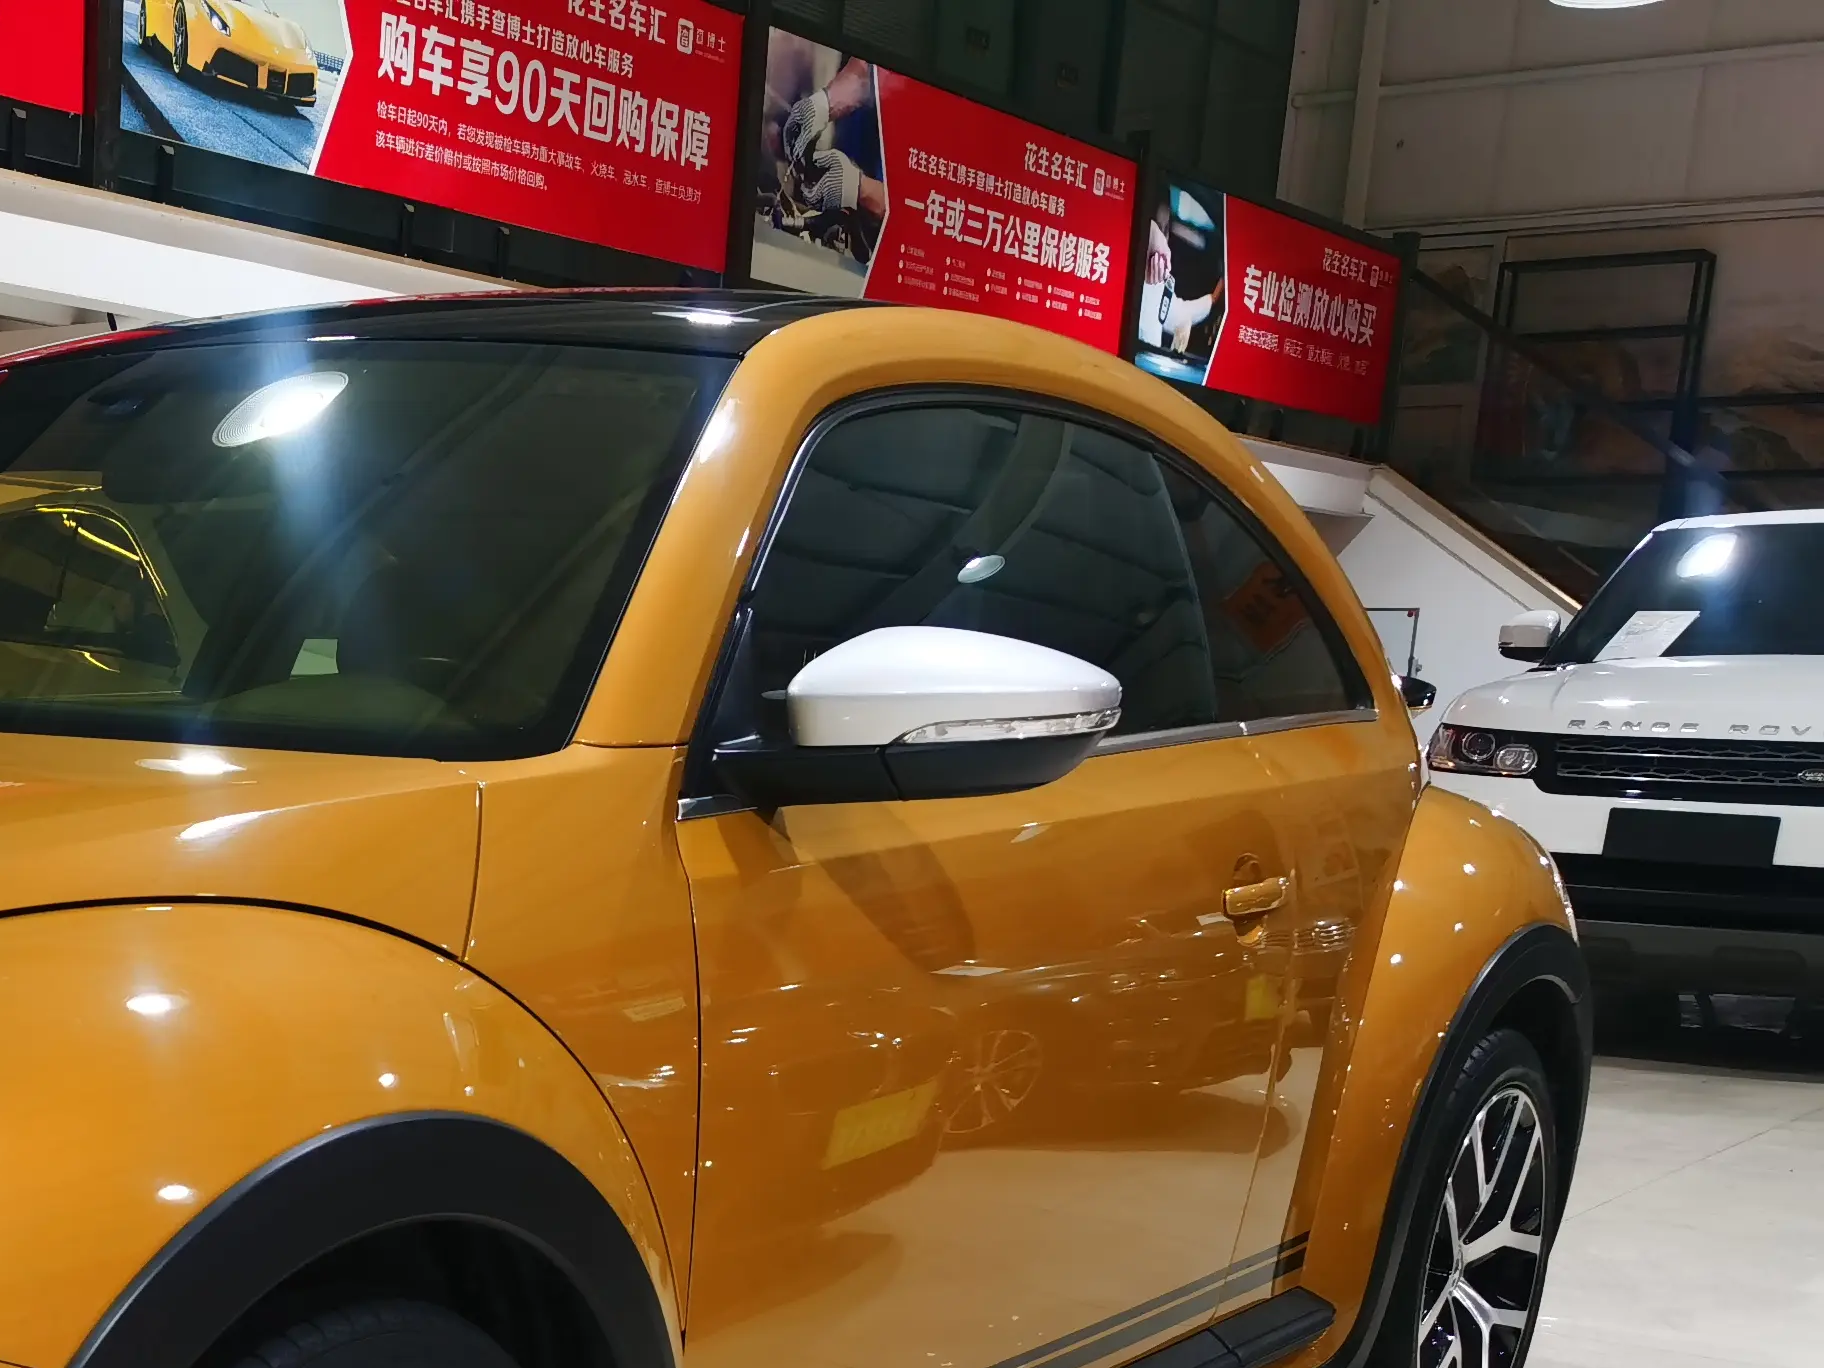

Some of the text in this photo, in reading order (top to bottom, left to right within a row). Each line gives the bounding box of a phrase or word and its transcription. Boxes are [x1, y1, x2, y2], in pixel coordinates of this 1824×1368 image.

[396, 0, 634, 78] 车汇携手查博士打造放心车服务
[377, 12, 711, 171] 购车享90天回购保障
[908, 147, 1065, 218] 花生名车汇携手查博士打造放心车服务
[1024, 141, 1089, 190] 花生名车汇
[904, 189, 1110, 285] 一年或三万公里保修服务
[1322, 247, 1368, 283] 花生名车汇
[1243, 264, 1377, 348] 专业检测放心购买
[1567, 718, 1824, 737] RANGE ROV
